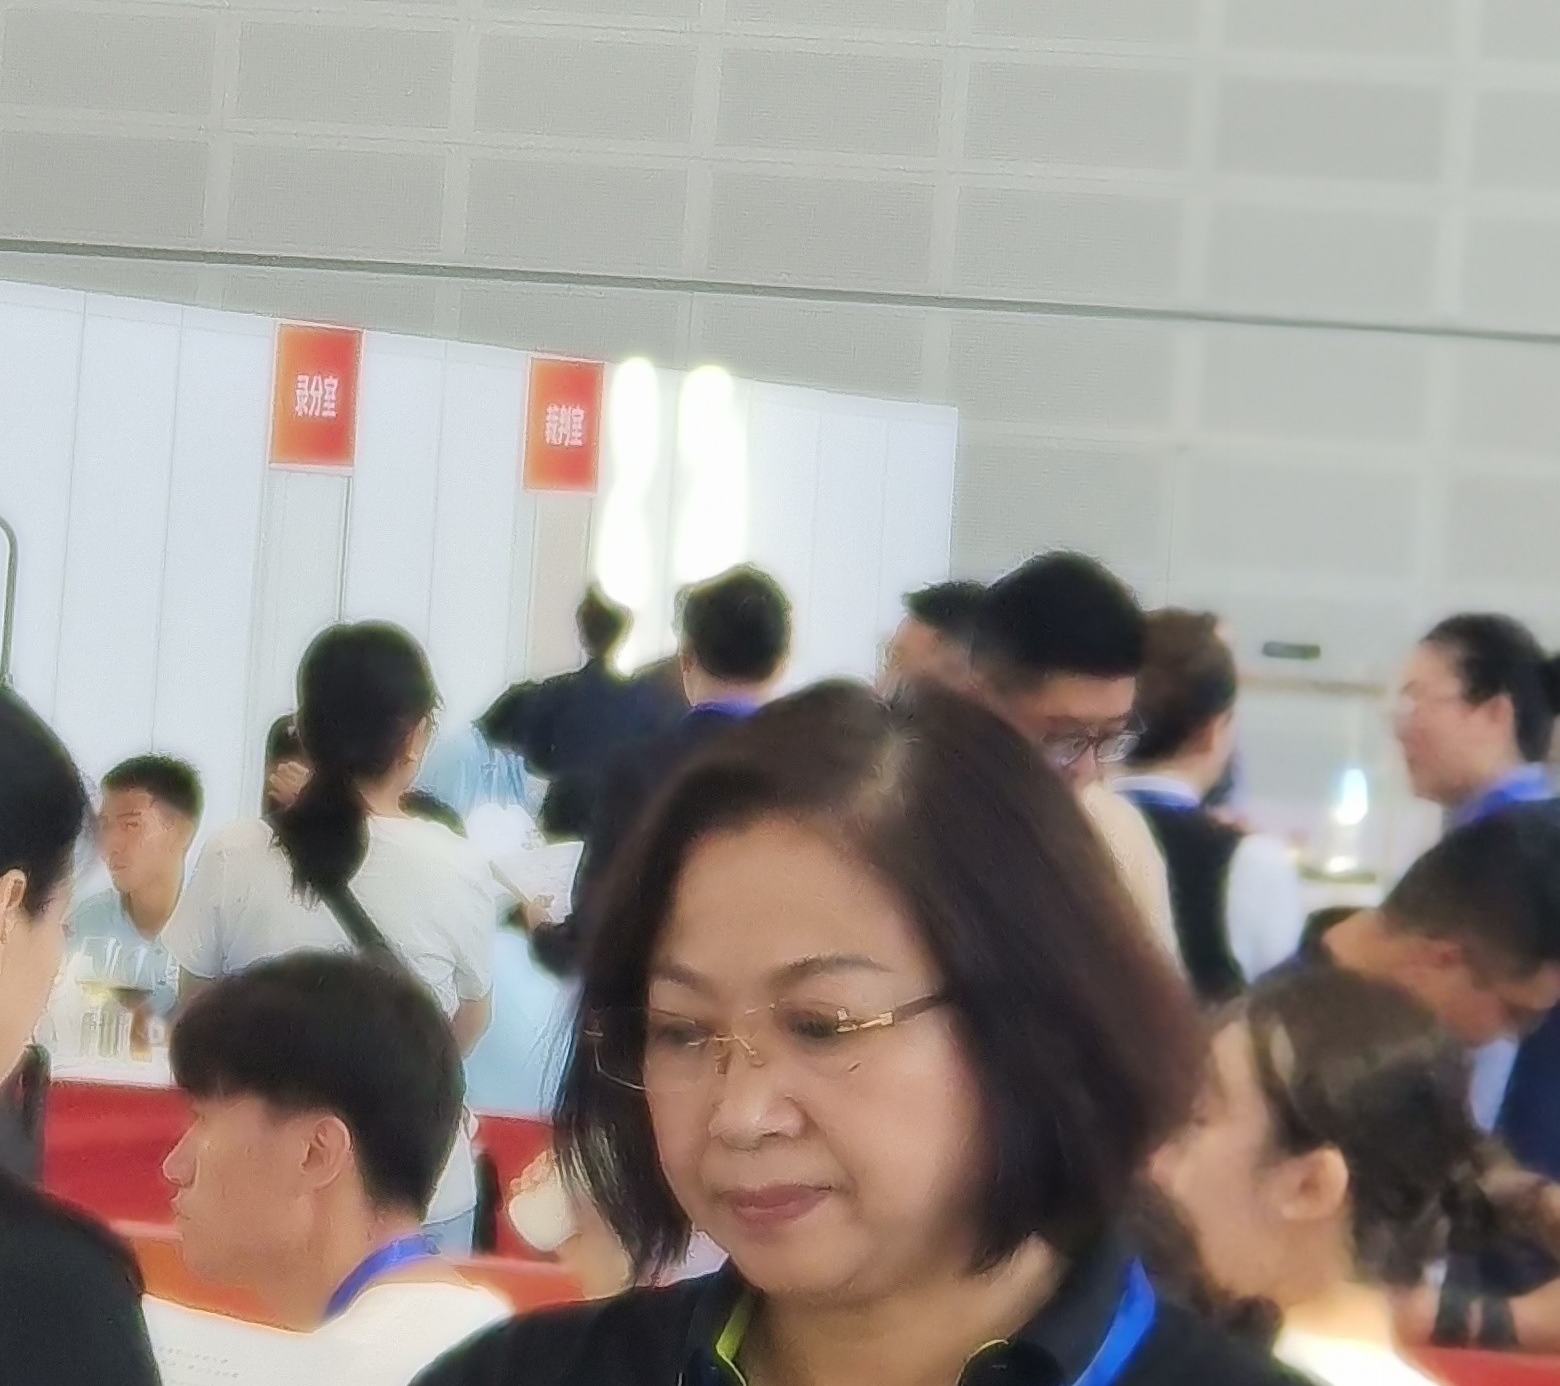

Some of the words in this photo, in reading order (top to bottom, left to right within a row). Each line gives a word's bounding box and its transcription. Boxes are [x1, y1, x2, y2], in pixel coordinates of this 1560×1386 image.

[294, 373, 339, 418] 录分室
[544, 403, 585, 447] 裁判室
